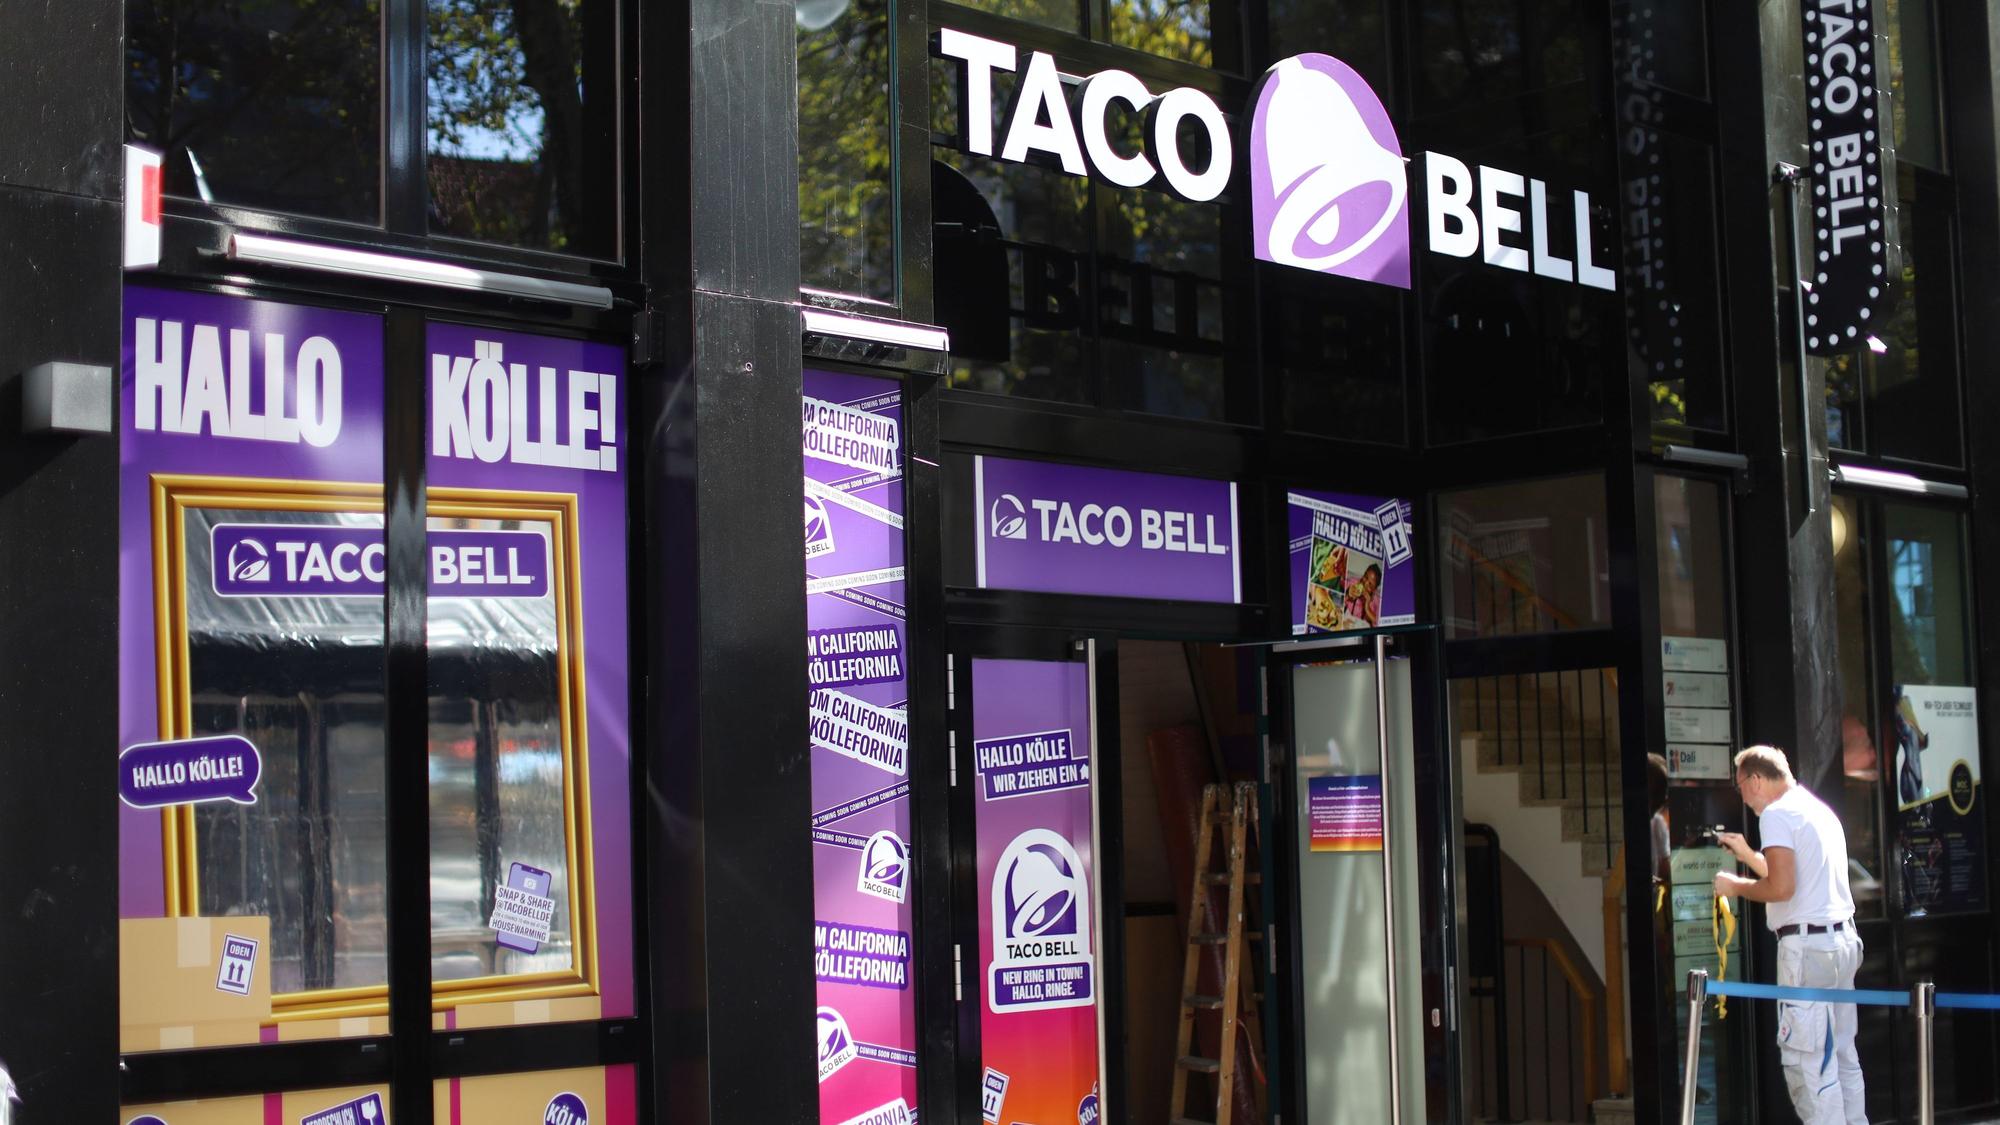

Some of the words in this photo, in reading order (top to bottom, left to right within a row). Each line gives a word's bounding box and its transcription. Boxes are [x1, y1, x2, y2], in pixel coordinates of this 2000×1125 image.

[940, 27, 1233, 202] TACO
[1424, 150, 1617, 292] BELL
[1826, 132, 1866, 256] BELL
[135, 317, 342, 448] HALLO
[432, 339, 617, 472] KÖLLE!
[819, 406, 895, 443] CALIFORNIA
[1031, 498, 1133, 548] TACO
[1140, 508, 1227, 555] BELL
[1315, 511, 1349, 544] HALLO
[1381, 509, 1399, 527] OBEN
[812, 542, 830, 553] BELL
[433, 546, 533, 584] BELL
[820, 629, 898, 655] CALIFORNIA
[832, 697, 907, 743] CALIFORNIA
[810, 715, 903, 769] KÖLLEFORNIA
[980, 743, 1024, 769] HALLO
[1026, 737, 1067, 763] KÖLLE
[132, 763, 185, 788] HALLO
[189, 756, 243, 781] KÖLLE!
[993, 773, 1016, 793] WIR
[1018, 767, 1057, 789] ZIEHEN
[1059, 764, 1078, 783] EIN
[498, 887, 520, 901] SNAP
[520, 893, 526, 904] &
[527, 895, 552, 911] SHARE
[863, 880, 882, 893] TACO
[883, 887, 901, 899] BELL
[496, 900, 550, 922] @TACOBELLDE
[492, 918, 547, 941] HOUSEWARMING
[829, 927, 907, 957] CALIFORNIA
[229, 943, 250, 958] OBEN
[1006, 943, 1043, 959] TACO
[1045, 941, 1078, 956] BELL
[1002, 970, 1022, 986] NEW
[1023, 968, 1044, 984] RING
[1045, 967, 1055, 982] IN
[1056, 966, 1083, 981] TOWN!
[1012, 983, 1044, 1001] HALLO,
[1045, 982, 1076, 998] RINGE.
[834, 1051, 851, 1066] BELL
